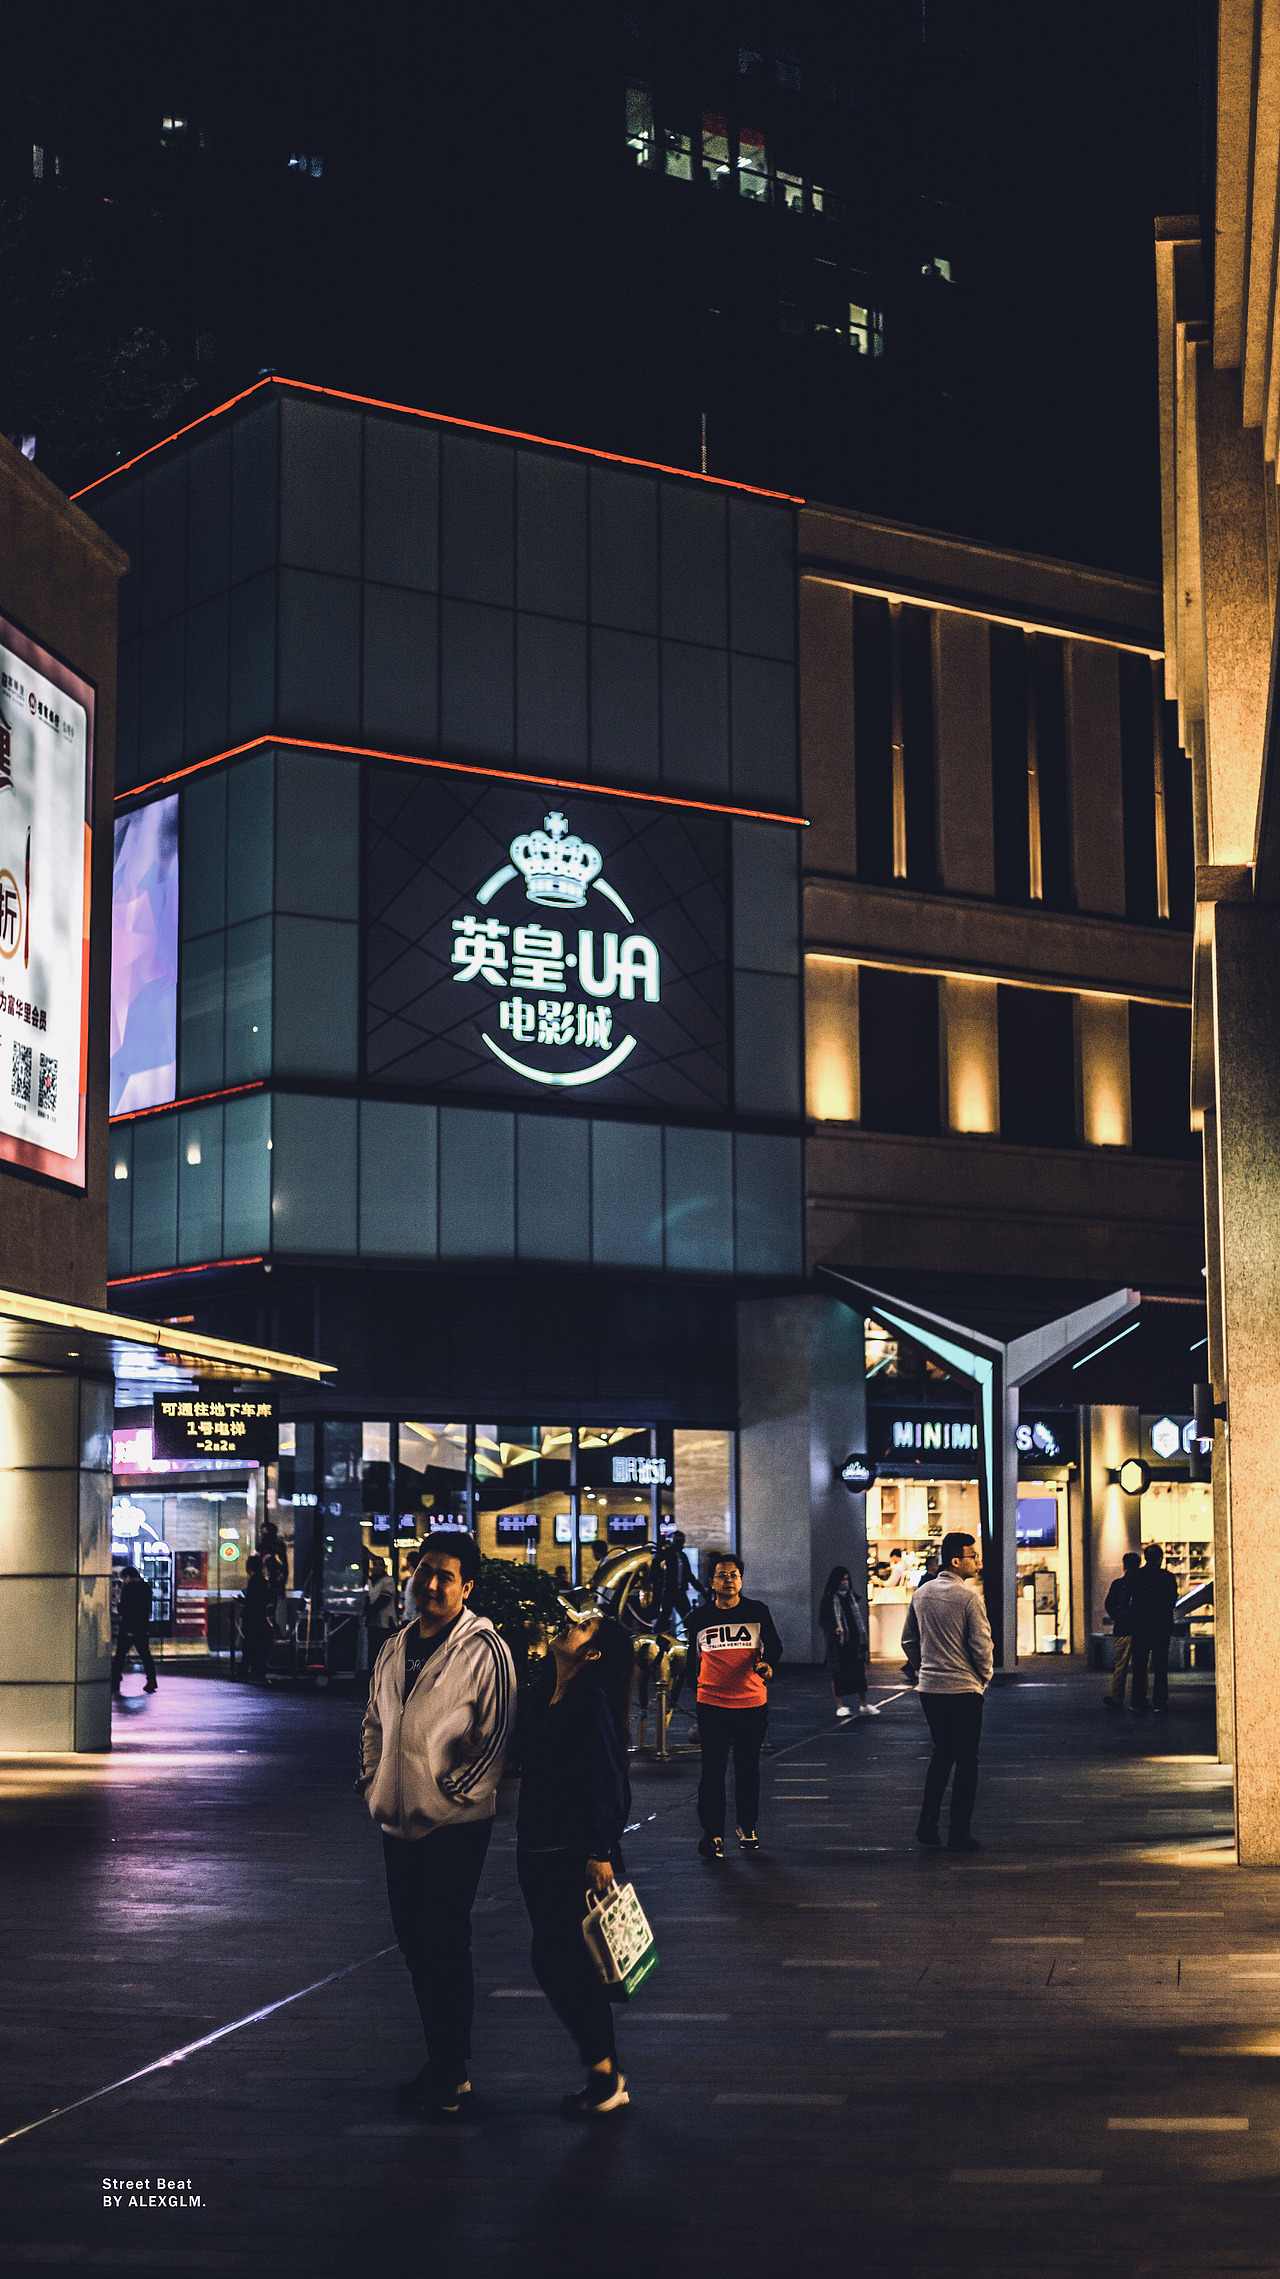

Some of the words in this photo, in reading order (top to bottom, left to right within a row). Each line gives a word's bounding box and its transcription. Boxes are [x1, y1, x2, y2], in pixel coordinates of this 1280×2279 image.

[500, 996, 613, 1050] 电影城
[161, 1402, 273, 1418] 可通往地下车库
[186, 1421, 247, 1437] 1号电梯
[706, 1626, 751, 1644] FILA
